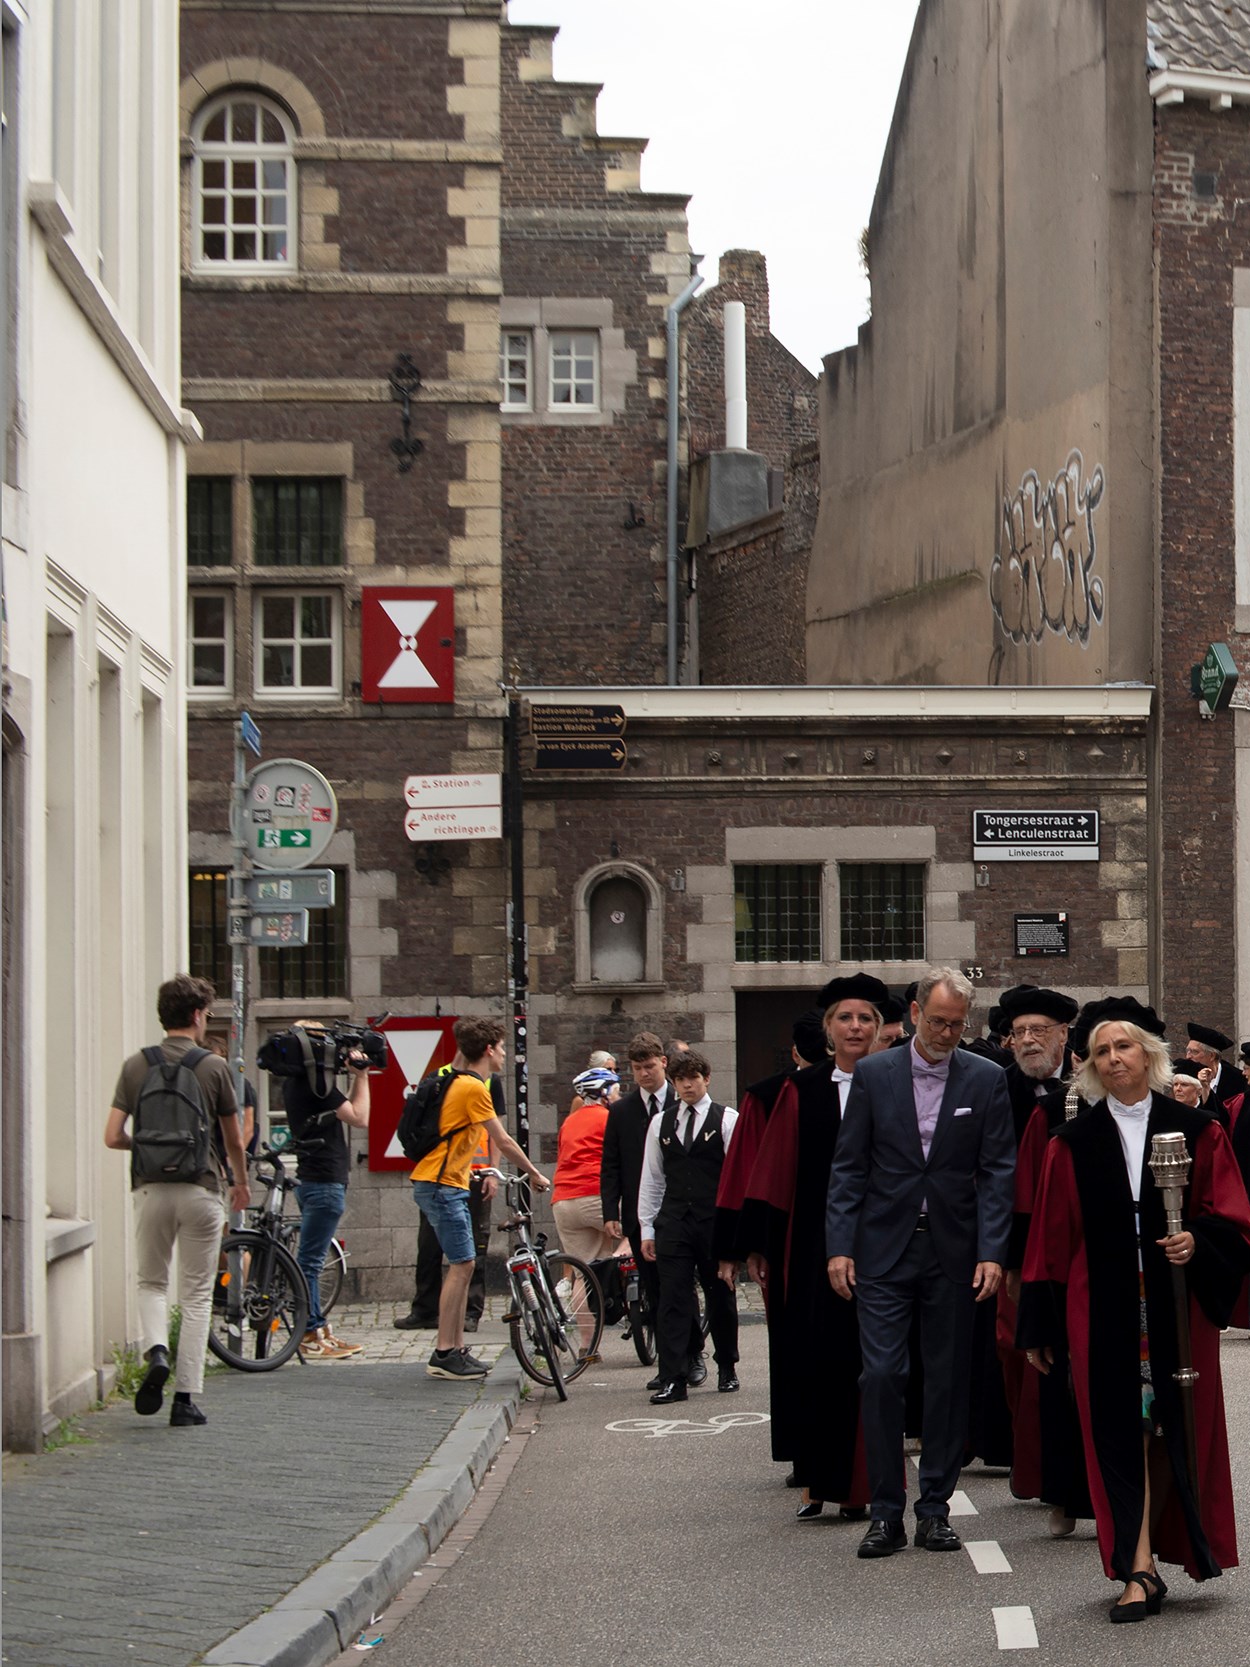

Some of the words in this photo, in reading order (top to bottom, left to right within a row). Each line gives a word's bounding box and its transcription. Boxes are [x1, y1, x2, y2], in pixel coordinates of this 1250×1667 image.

[533, 707, 593, 716] Stadsomwalling
[560, 743, 577, 751] Eyck
[433, 779, 470, 789] Station
[421, 812, 457, 822] Andere
[983, 814, 1074, 828] Tongersestraat
[434, 825, 486, 835] richtingen
[998, 828, 1089, 839] Lenculenstraat
[1008, 849, 1064, 857] Linkelestraot
[966, 967, 983, 979] 33
